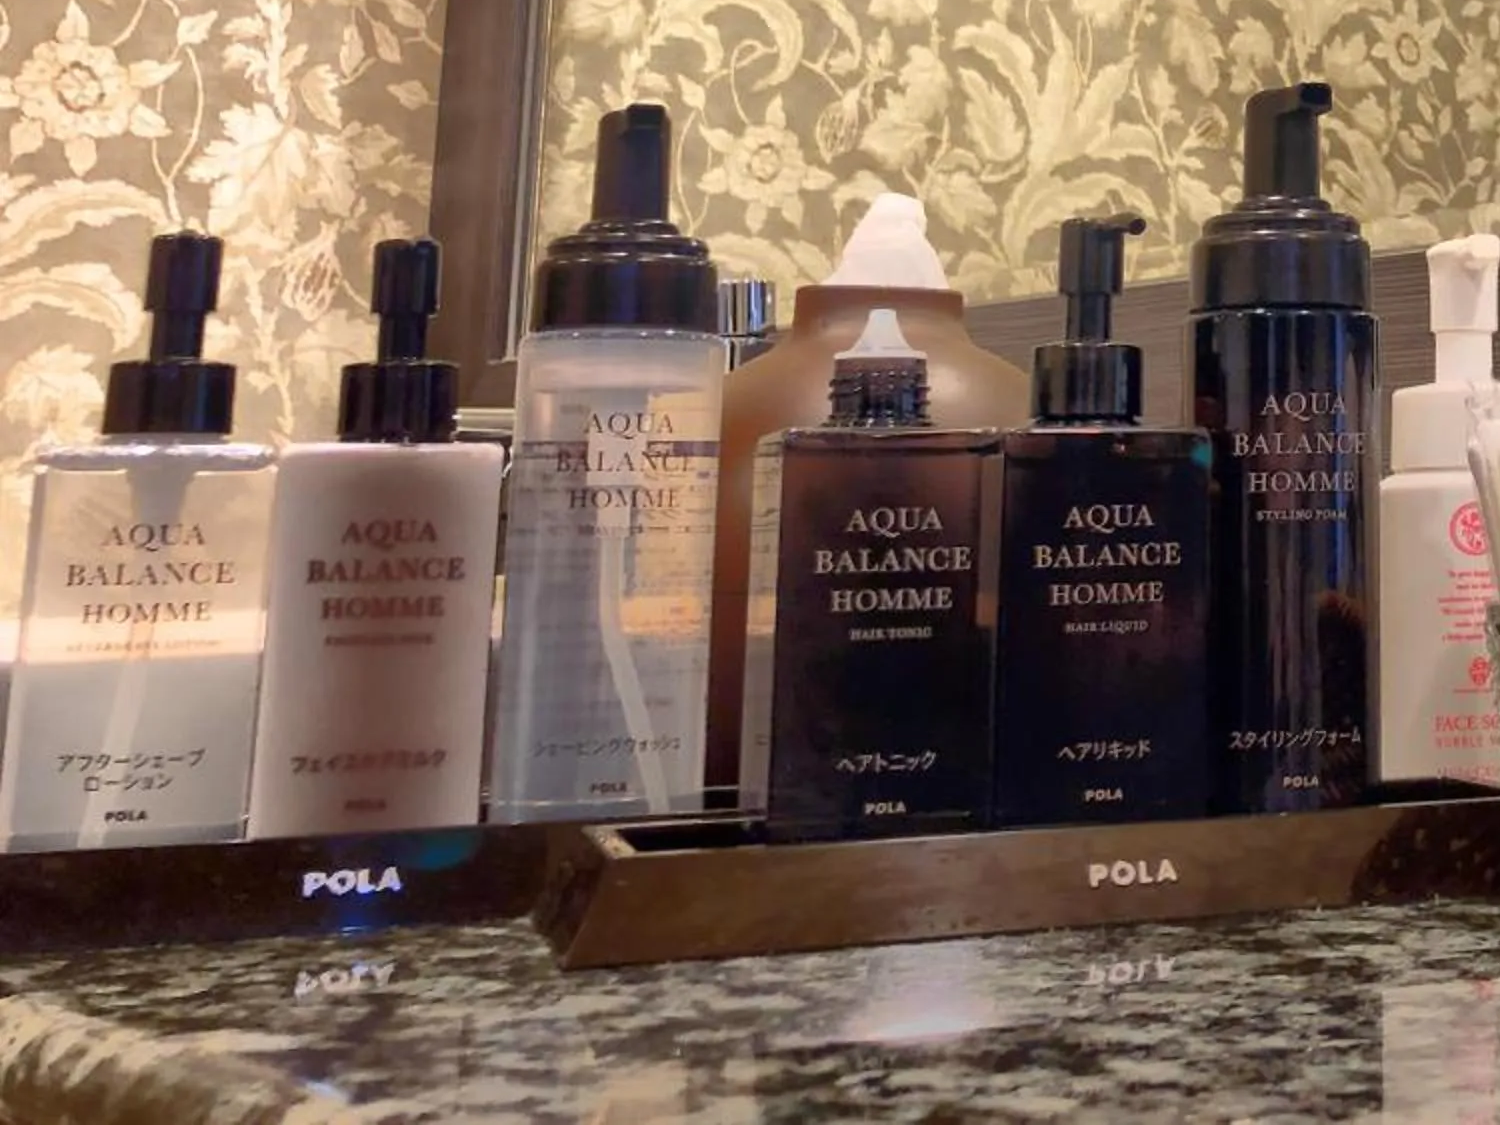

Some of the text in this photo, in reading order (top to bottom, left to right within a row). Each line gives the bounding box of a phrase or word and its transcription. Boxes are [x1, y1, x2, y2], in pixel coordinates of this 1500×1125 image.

[1260, 392, 1346, 421] AQUA
[583, 412, 674, 439] AQUA
[1233, 433, 1367, 457] BALANCE
[556, 450, 696, 472] BALANCE
[1248, 471, 1355, 493] HOMME
[569, 488, 680, 508] HOMME
[846, 506, 943, 538] AQUA
[1063, 504, 1155, 534] AQUA
[101, 523, 205, 552] AQUA
[341, 519, 438, 552] AQUA
[814, 546, 972, 573] BALANCE
[1031, 542, 1182, 569] BALANCE
[66, 561, 236, 587] BALANCE
[306, 557, 466, 584] BALANCE
[831, 587, 953, 612] HOMME
[1049, 580, 1164, 606] HOMME
[82, 601, 213, 624] HOMME
[321, 595, 445, 620] HOMME
[849, 628, 885, 641] HAIR
[1065, 620, 1149, 634] HAIR LIQUID
[1435, 714, 1477, 732] FACE
[1229, 726, 1361, 749] スタイリングフォーム
[835, 751, 937, 773] ヘアトニック
[1057, 739, 1152, 762] ヘアリキッド
[83, 773, 174, 792] ローション
[1283, 776, 1319, 787] POLA
[1084, 788, 1123, 802] POLA
[104, 810, 149, 822] POLA
[864, 801, 907, 815] POLA
[302, 866, 403, 898] POLA
[1089, 859, 1178, 888] POLA
